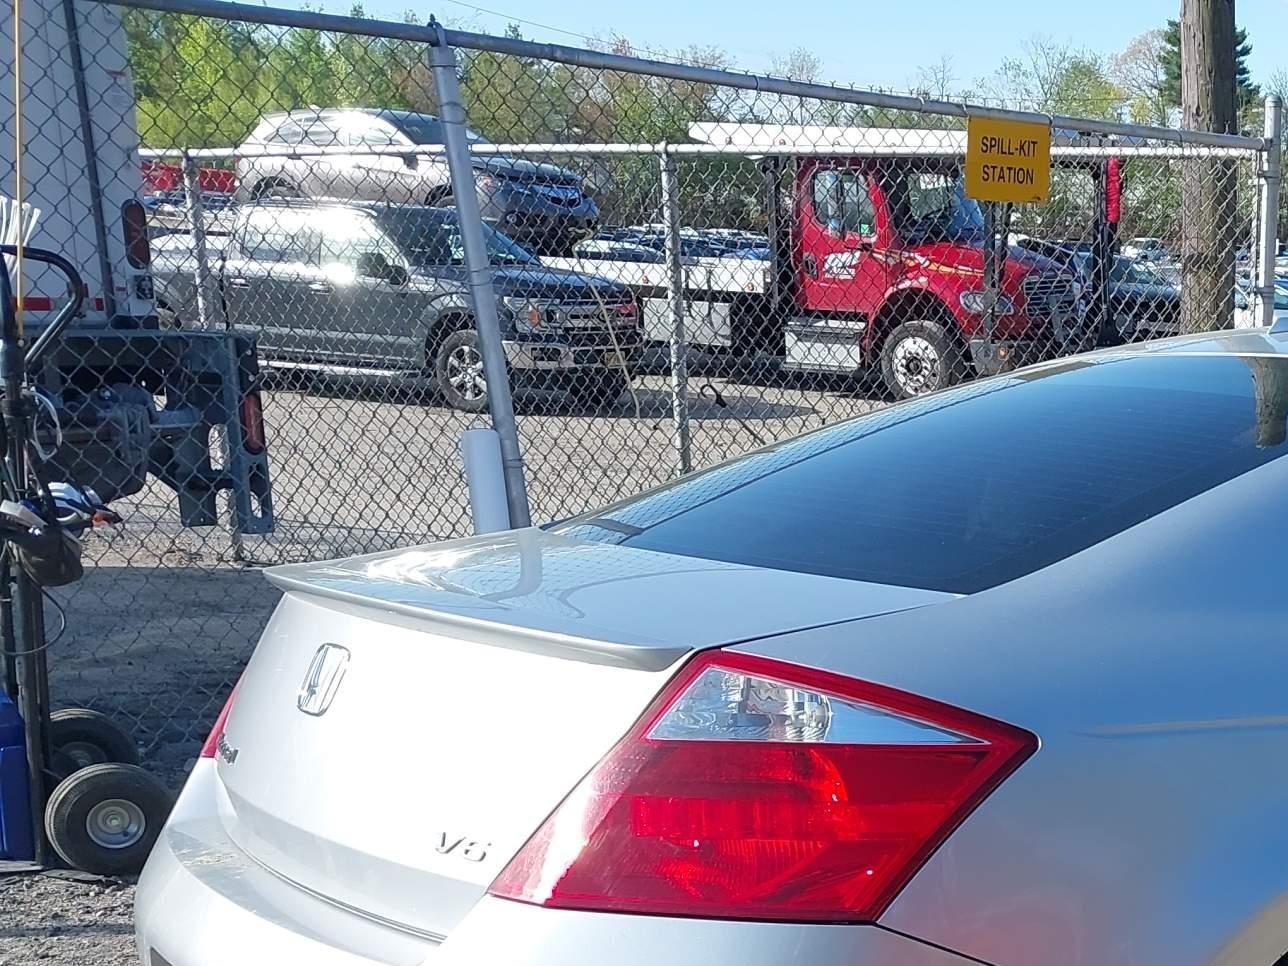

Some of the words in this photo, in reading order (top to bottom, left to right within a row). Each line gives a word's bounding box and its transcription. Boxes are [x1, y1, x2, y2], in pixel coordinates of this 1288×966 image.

[981, 135, 1038, 158] SPILL-KIT
[982, 164, 1034, 185] STATION
[434, 831, 491, 862] V6
